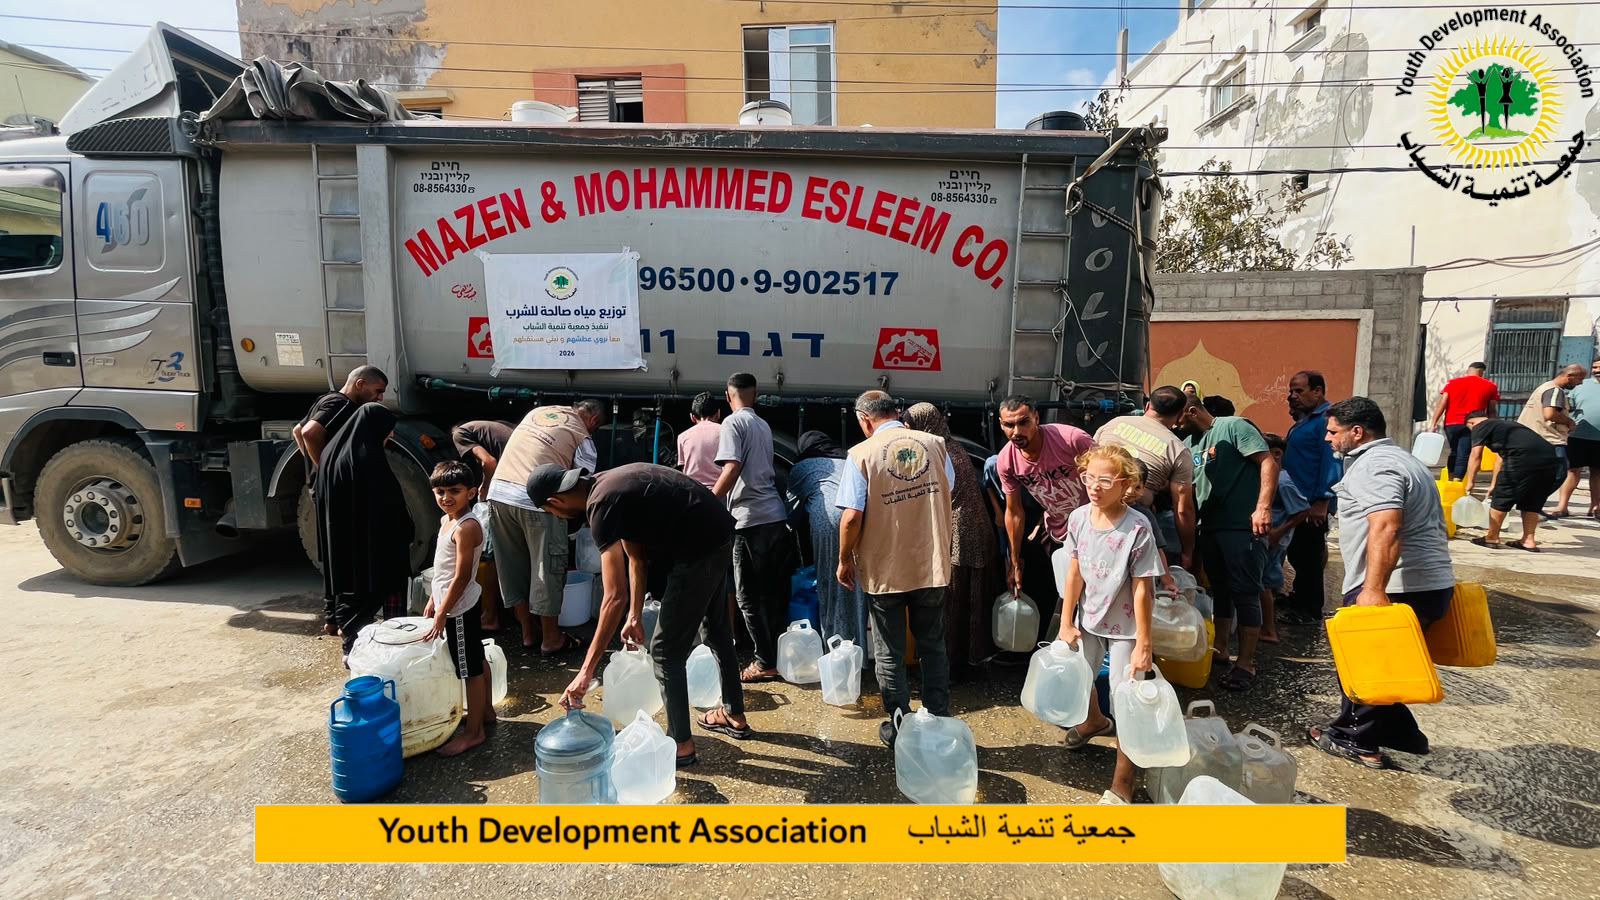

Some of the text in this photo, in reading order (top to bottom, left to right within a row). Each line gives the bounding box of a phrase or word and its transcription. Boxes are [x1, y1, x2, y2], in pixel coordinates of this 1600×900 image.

[431, 161, 460, 170] חיים
[949, 170, 980, 180] חיים
[413, 183, 467, 193] 08-8564330
[931, 192, 988, 204] 08-8564330
[96, 202, 150, 246] 460
[404, 167, 1009, 290] MAZEN & MOHAMMED ESLEEM CO.
[505, 304, 627, 319] توزيع مياه صالحة للشرب
[522, 322, 609, 331] تنفيذ جمعية تنمية الشباب
[716, 330, 825, 357] דגם
[559, 349, 576, 357] 2026
